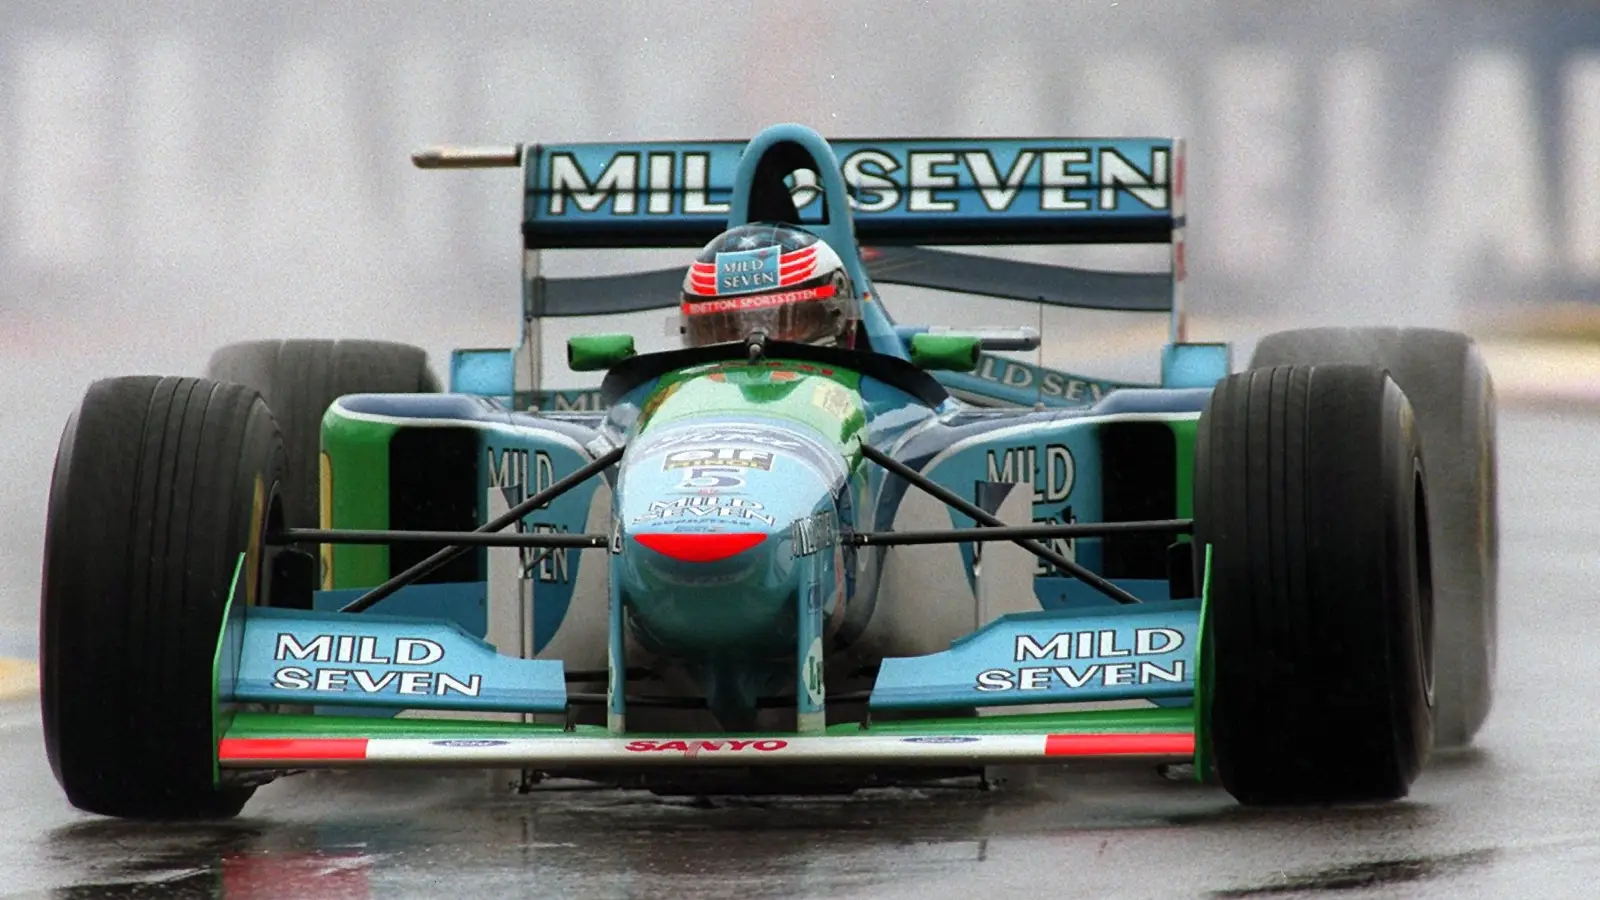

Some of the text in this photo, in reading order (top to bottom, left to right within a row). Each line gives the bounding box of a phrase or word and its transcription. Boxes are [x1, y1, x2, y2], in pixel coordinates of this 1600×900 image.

[842, 147, 1172, 212] SEVEN
[723, 259, 764, 273] MILD
[723, 271, 775, 289] SEVEN
[487, 446, 553, 509] MILD
[681, 466, 743, 489] 5
[274, 632, 445, 666] MILD
[1014, 627, 1186, 662] MILD
[270, 667, 482, 697] SEVEN
[974, 660, 1186, 692] SEVEN
[624, 740, 788, 753] SANYO
